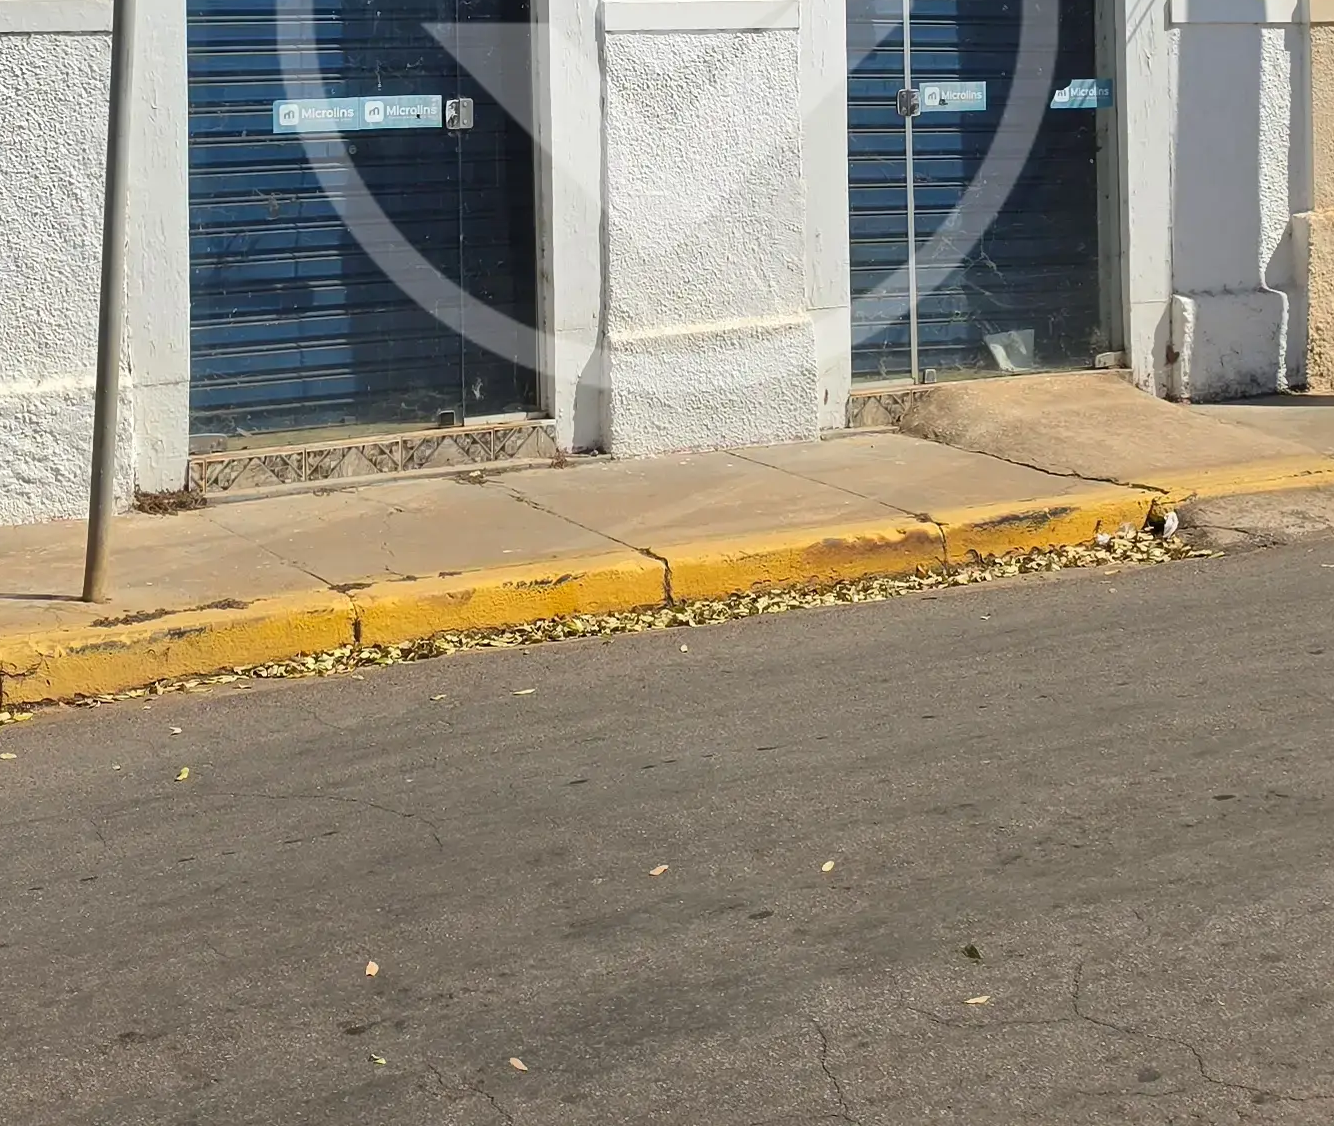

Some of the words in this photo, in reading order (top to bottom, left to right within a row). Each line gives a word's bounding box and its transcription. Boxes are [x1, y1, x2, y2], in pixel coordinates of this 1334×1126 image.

[941, 90, 983, 100] Microlins
[301, 107, 354, 119] Microlins
[386, 105, 437, 116] Microlins
